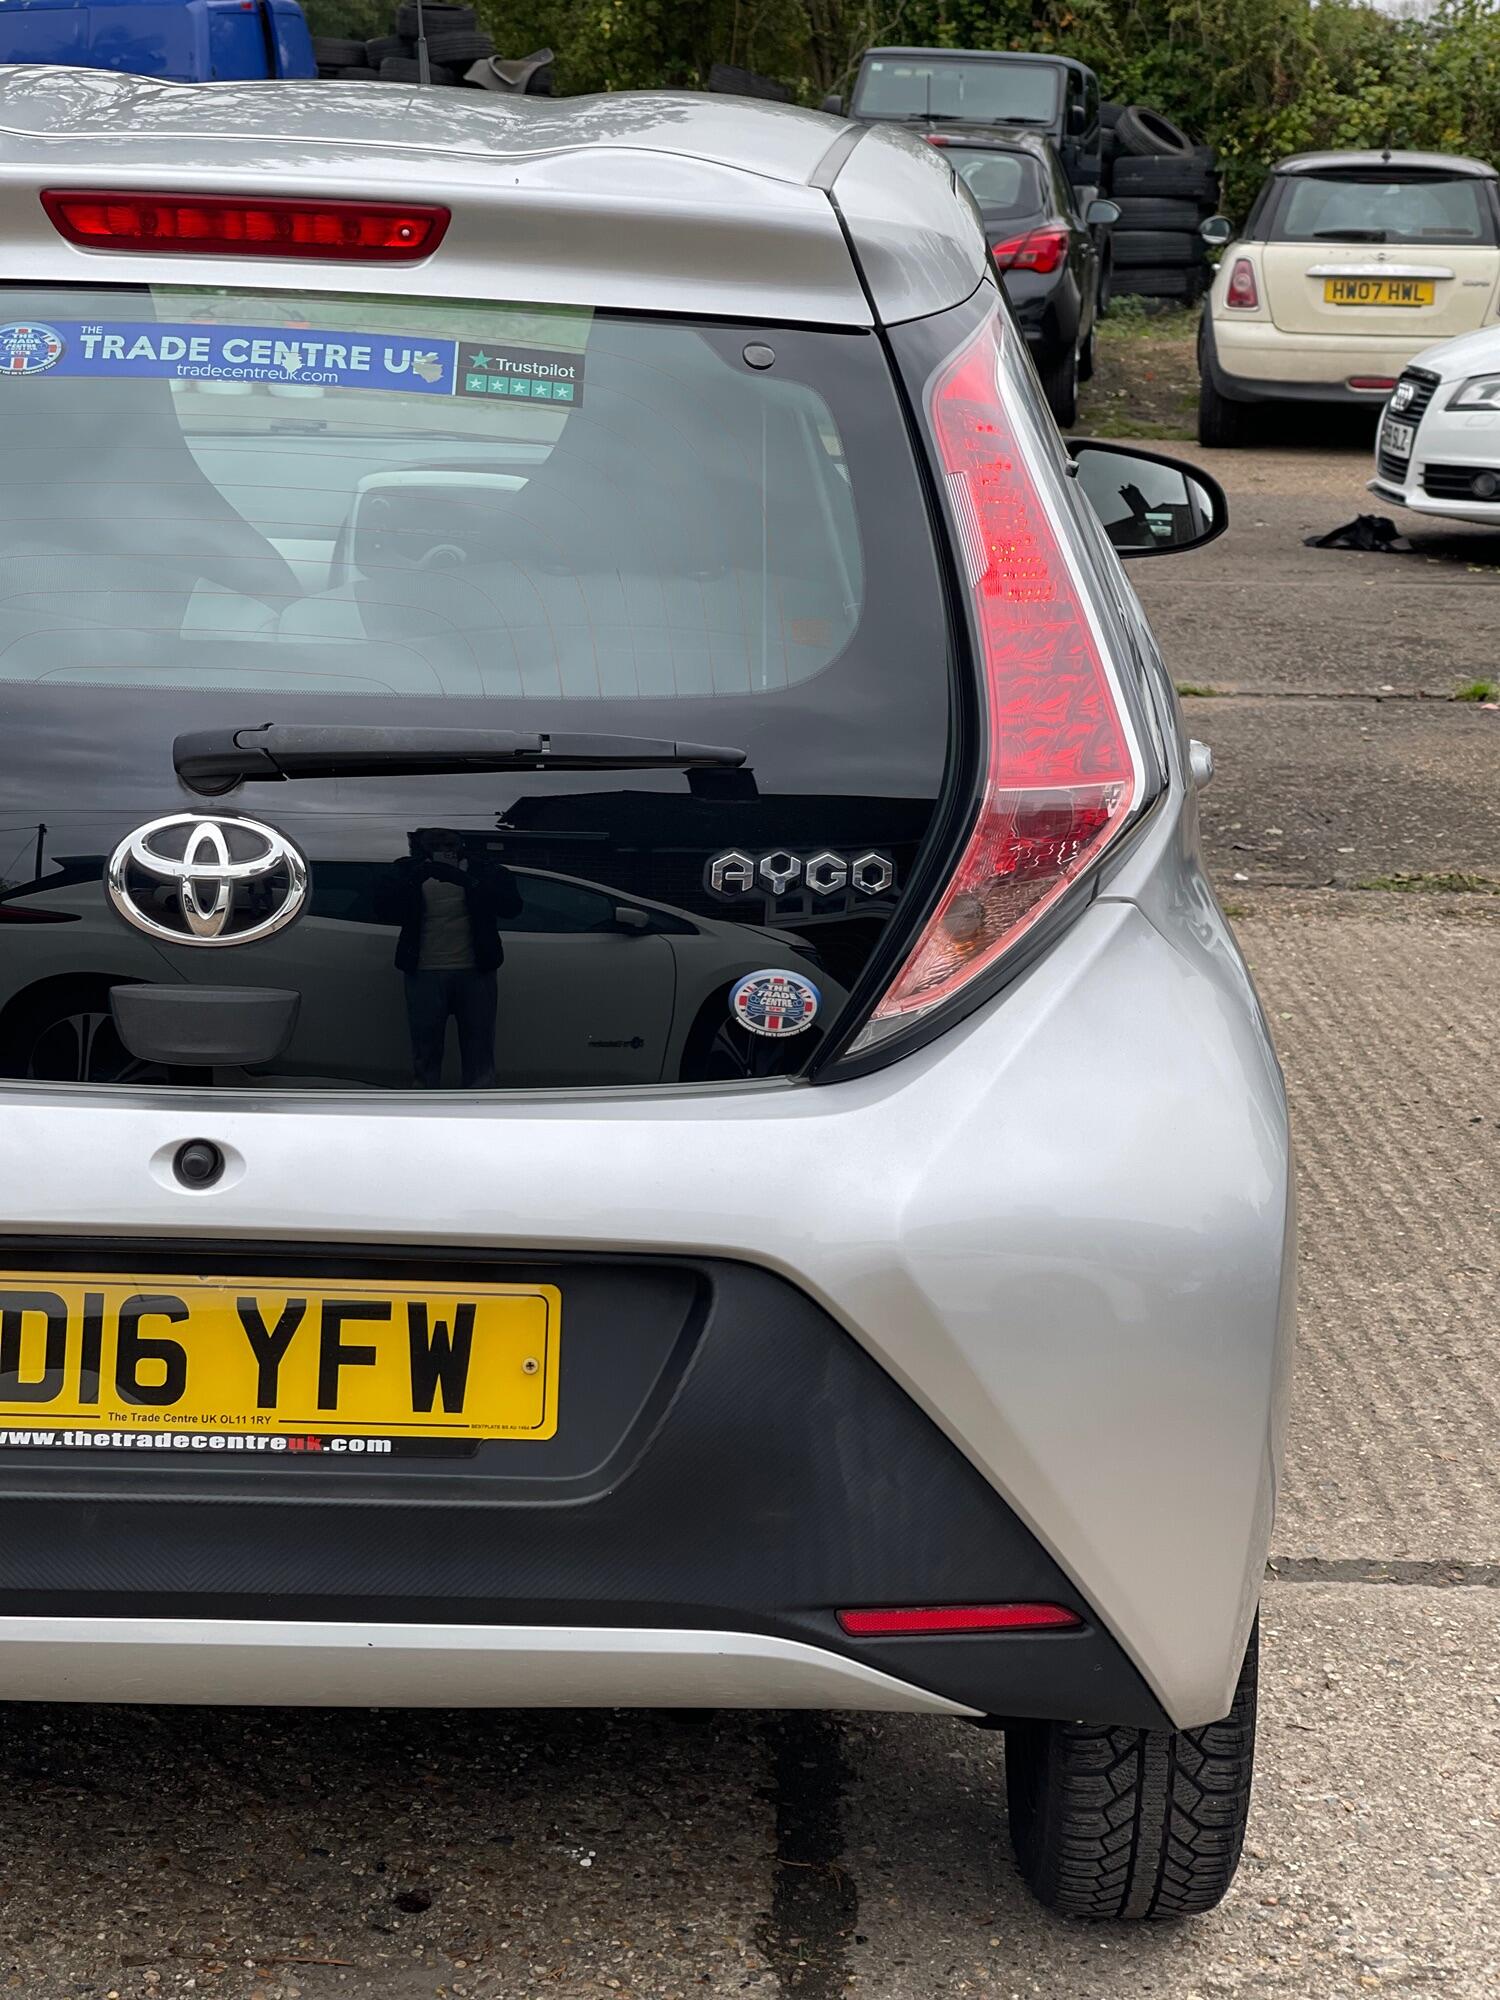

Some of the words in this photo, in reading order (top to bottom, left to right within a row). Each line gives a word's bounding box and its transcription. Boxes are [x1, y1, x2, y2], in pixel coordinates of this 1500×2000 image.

[1332, 281, 1383, 300] HW07
[1388, 282, 1425, 302] HWL
[80, 325, 103, 334] THE
[80, 334, 211, 362] TRADE
[222, 338, 371, 371] CENTRE
[176, 363, 338, 383] tradecentreuk.com
[495, 358, 575, 378] Trustpilot
[711, 851, 893, 895] AYGO
[757, 991, 797, 1000] TRADE
[760, 998, 793, 1007] CENTRE
[237, 1297, 477, 1413] YFW
[108, 1412, 128, 1422] The
[130, 1412, 160, 1422] Trade
[163, 1413, 198, 1424] Centre
[201, 1414, 217, 1424] UK
[220, 1415, 246, 1425] OL11
[251, 1416, 271, 1425] 1RY
